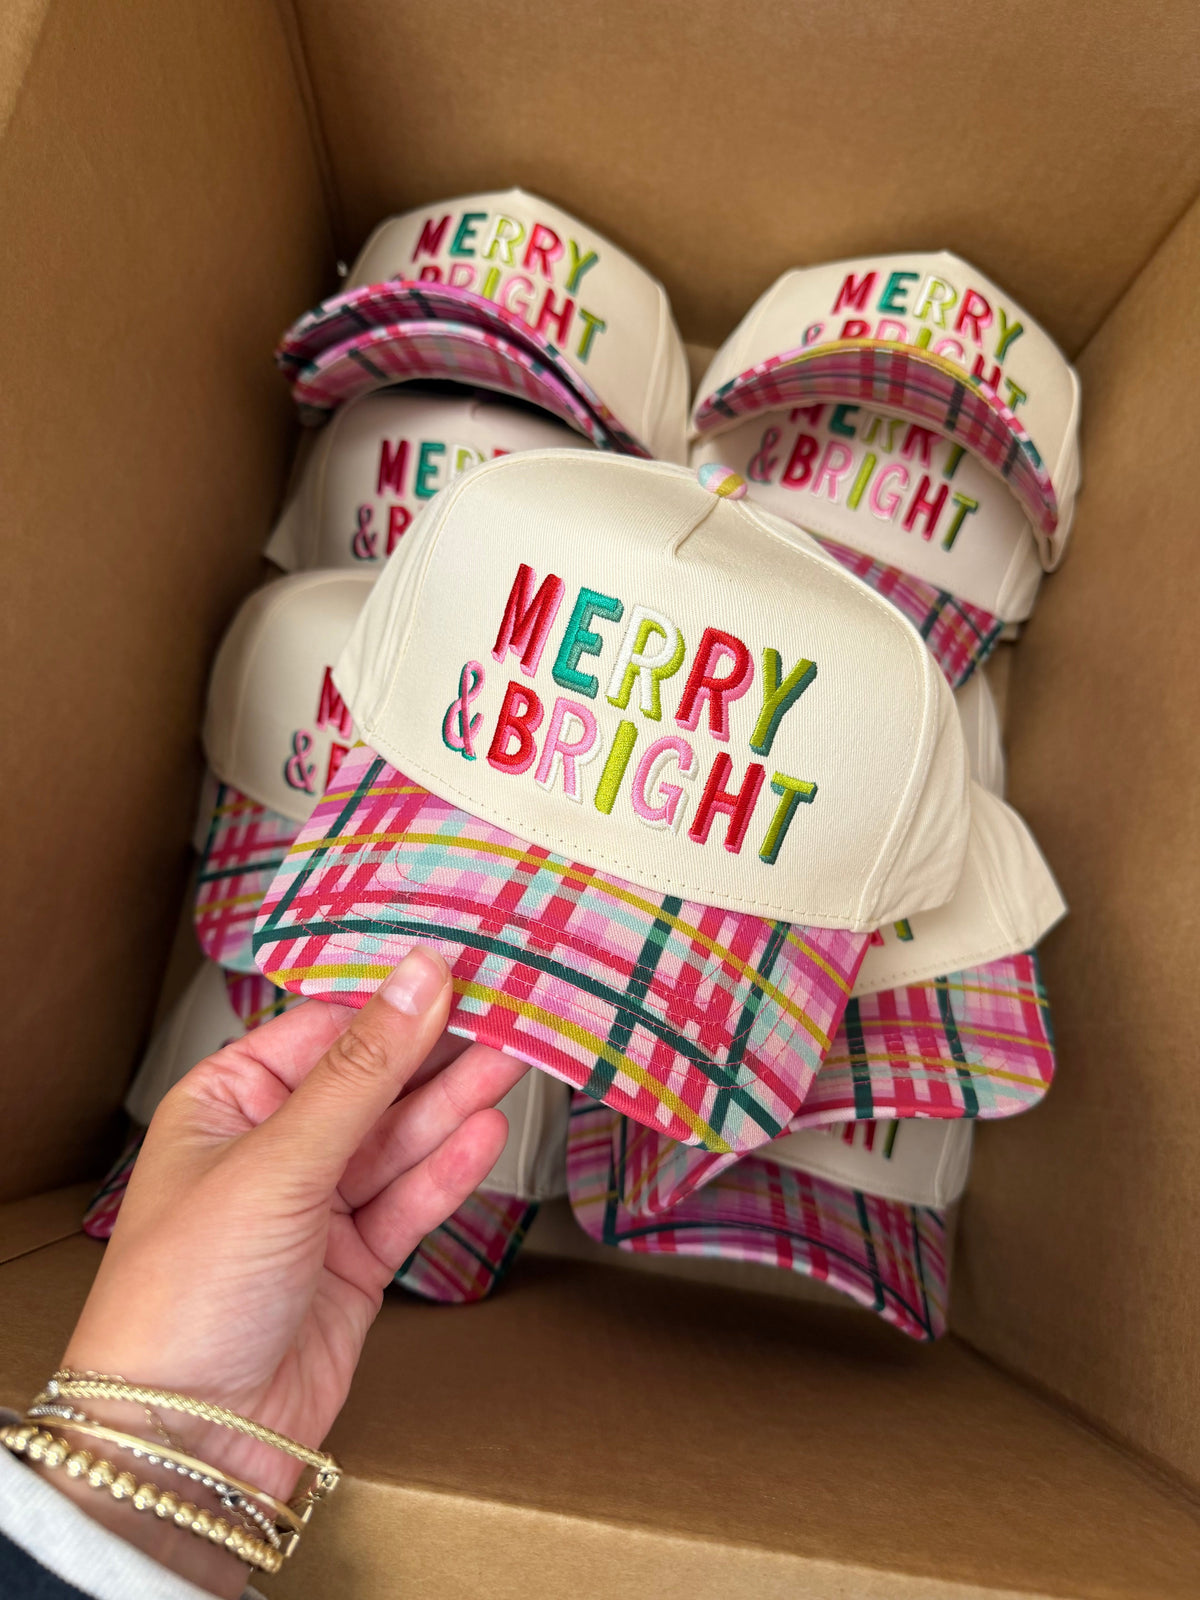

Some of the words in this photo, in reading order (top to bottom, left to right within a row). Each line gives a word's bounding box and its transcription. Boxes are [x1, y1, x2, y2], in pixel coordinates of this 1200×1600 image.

[411, 212, 599, 298] MERRY
[831, 271, 1024, 366] MERRY
[490, 562, 818, 758] MERRY
